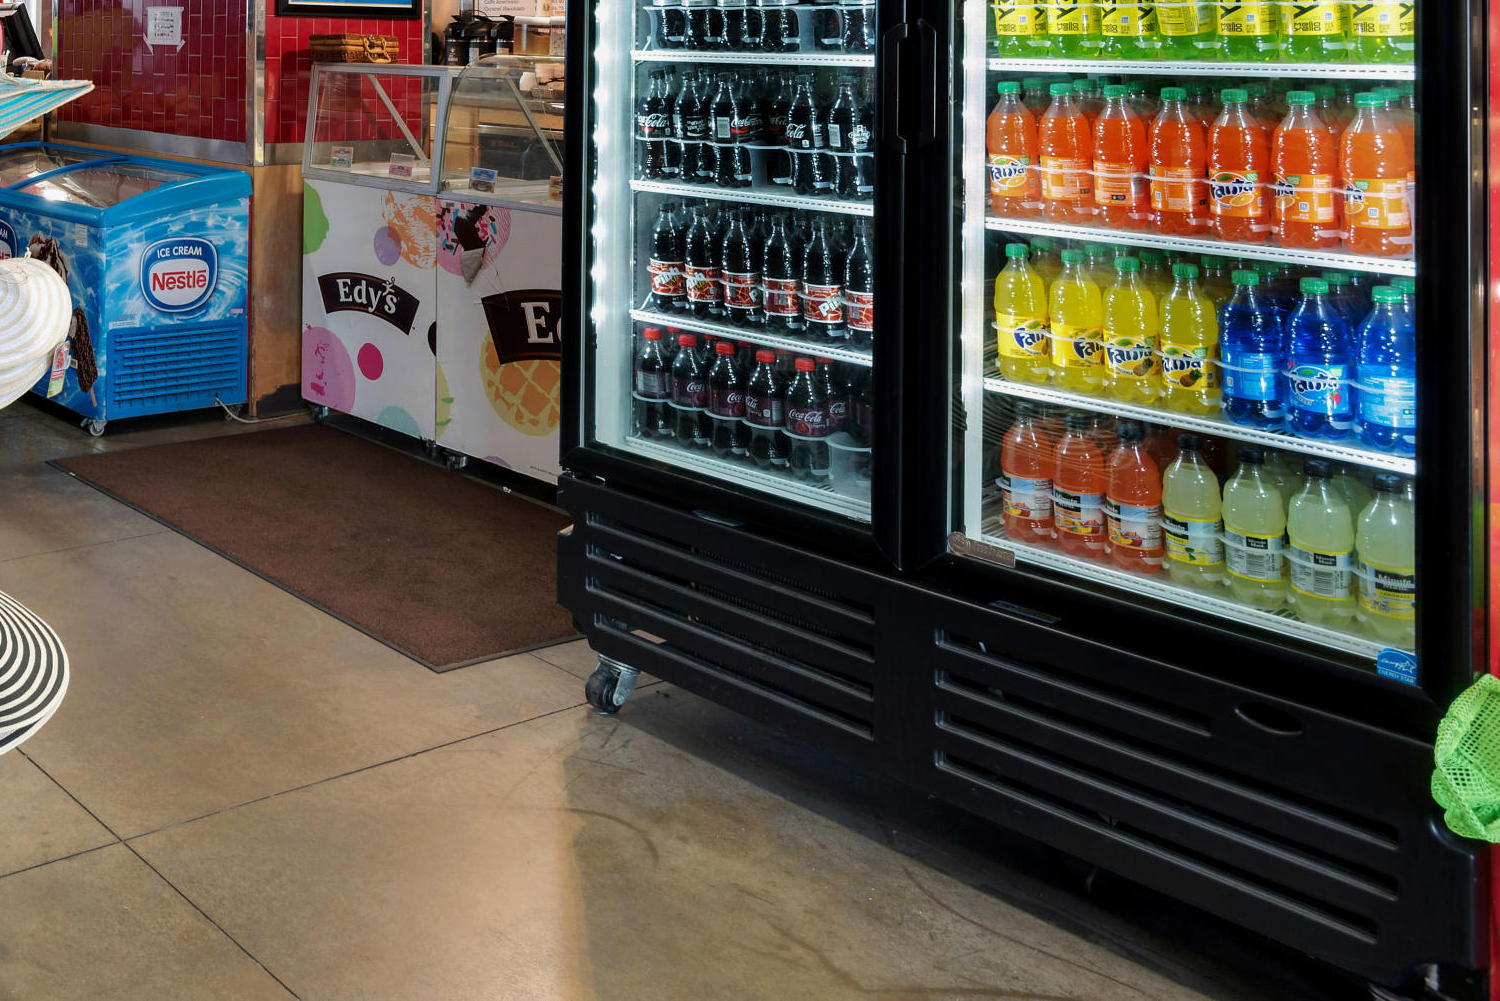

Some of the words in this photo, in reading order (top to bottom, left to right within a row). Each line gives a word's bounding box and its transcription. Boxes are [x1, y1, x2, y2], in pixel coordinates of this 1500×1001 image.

[157, 248, 171, 258] ICE
[172, 246, 202, 257] CREAM
[336, 278, 398, 314] Edy's
